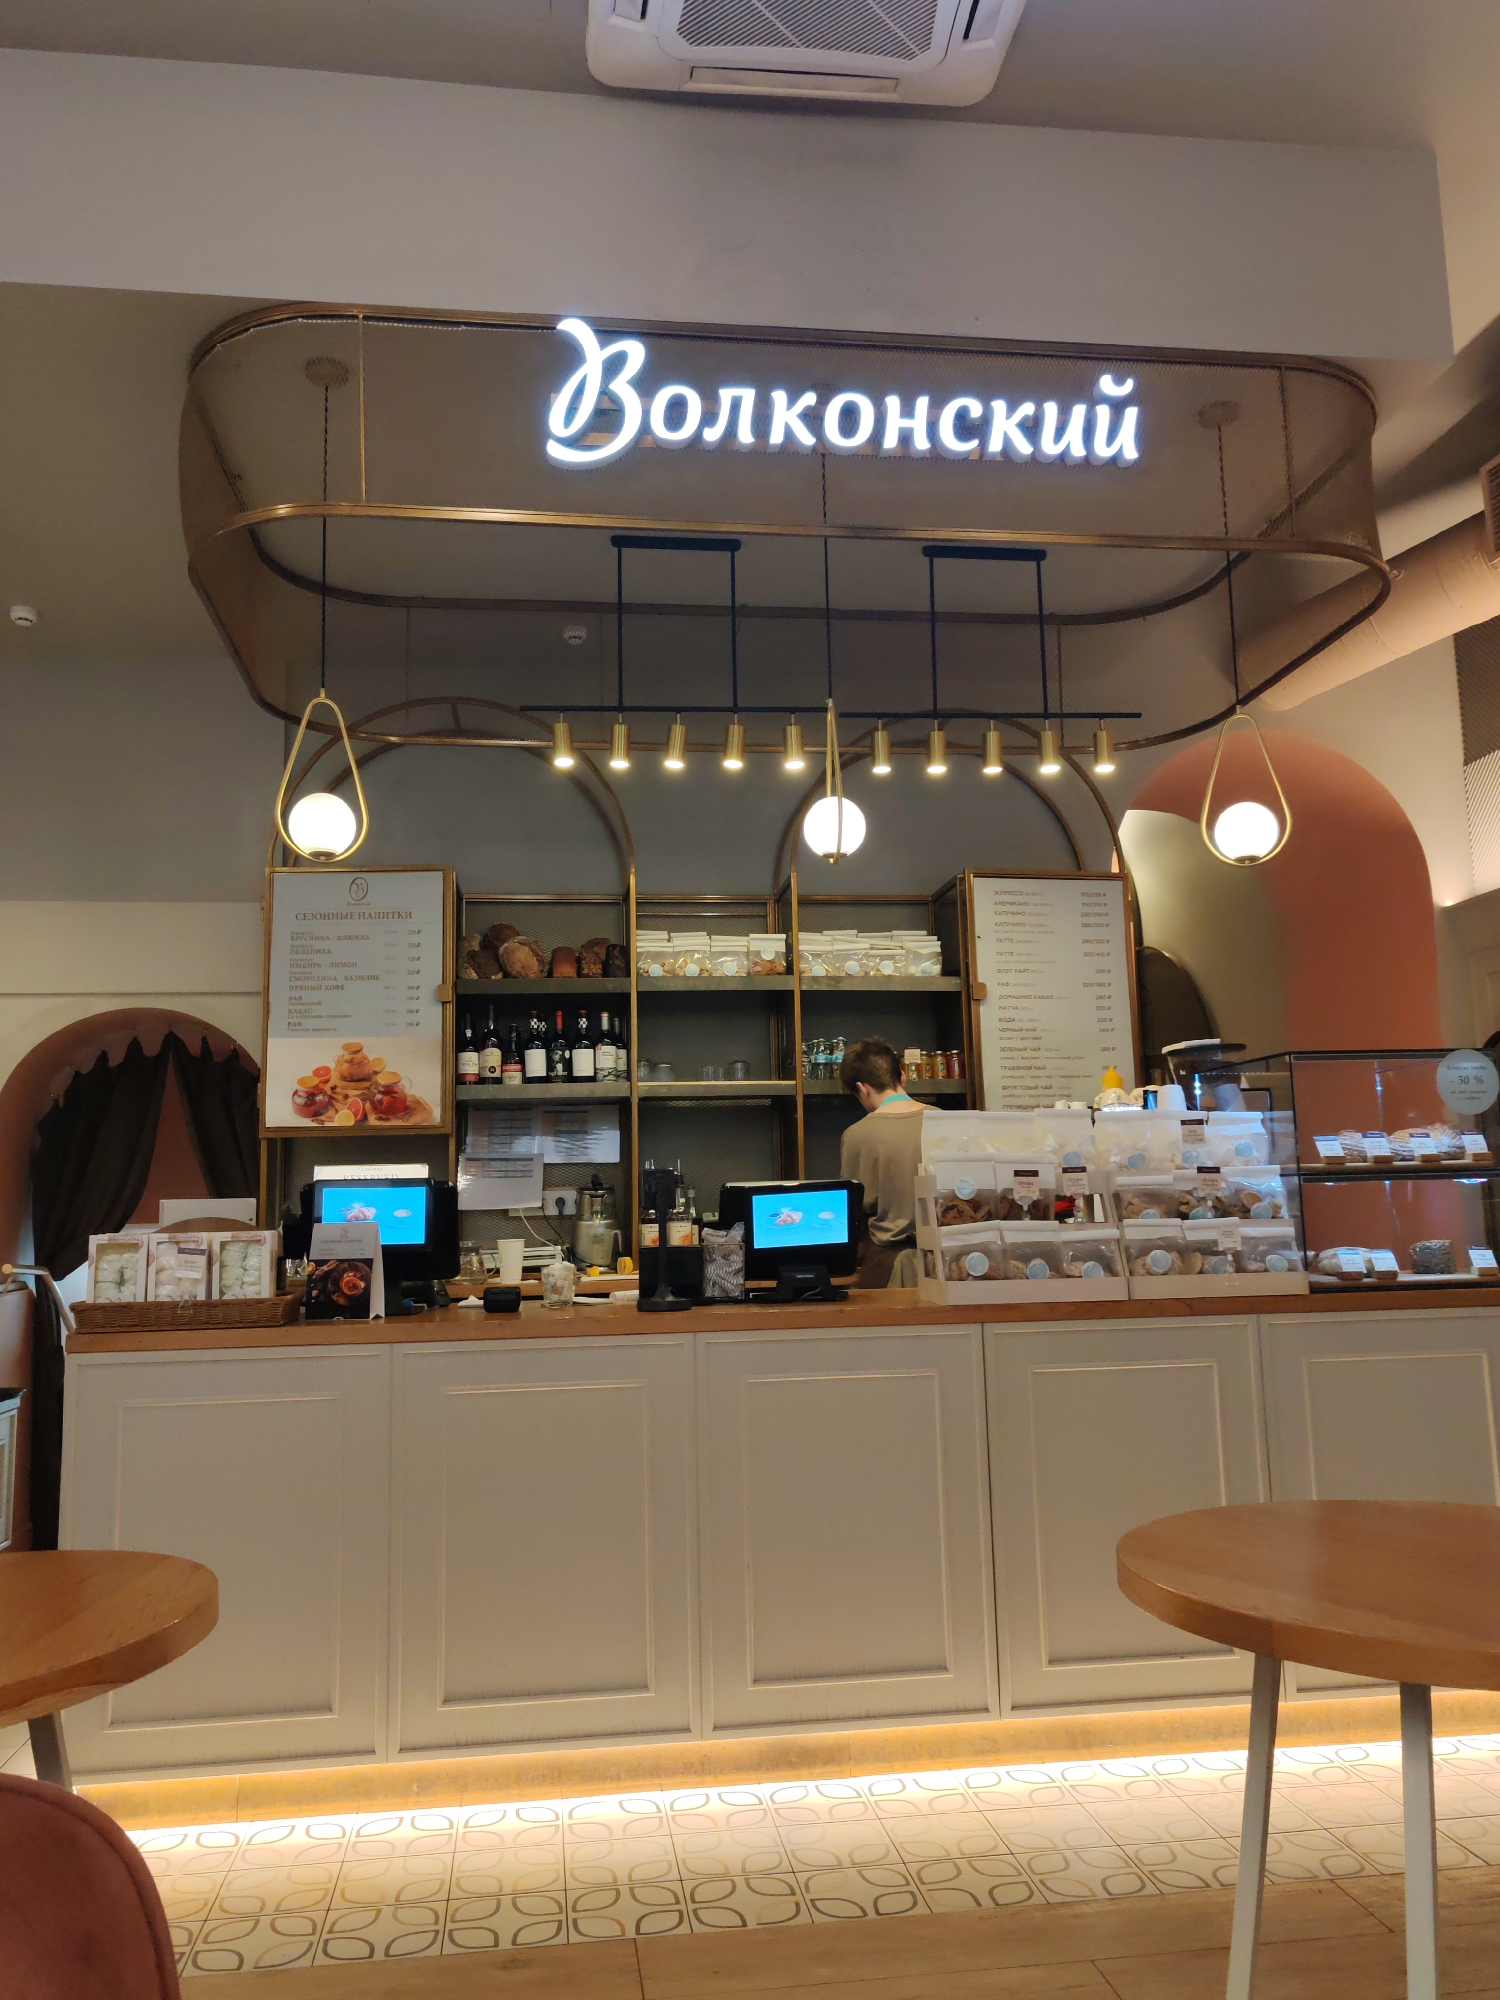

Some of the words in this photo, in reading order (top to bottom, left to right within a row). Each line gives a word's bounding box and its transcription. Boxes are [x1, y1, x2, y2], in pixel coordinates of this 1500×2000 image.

[546, 317, 1141, 465] Волконский
[295, 912, 355, 921] СЕЗОННЫЕ
[358, 911, 413, 920] НАПИТКИ
[1458, 1075, 1470, 1085] 30
[1473, 1075, 1484, 1085] %
